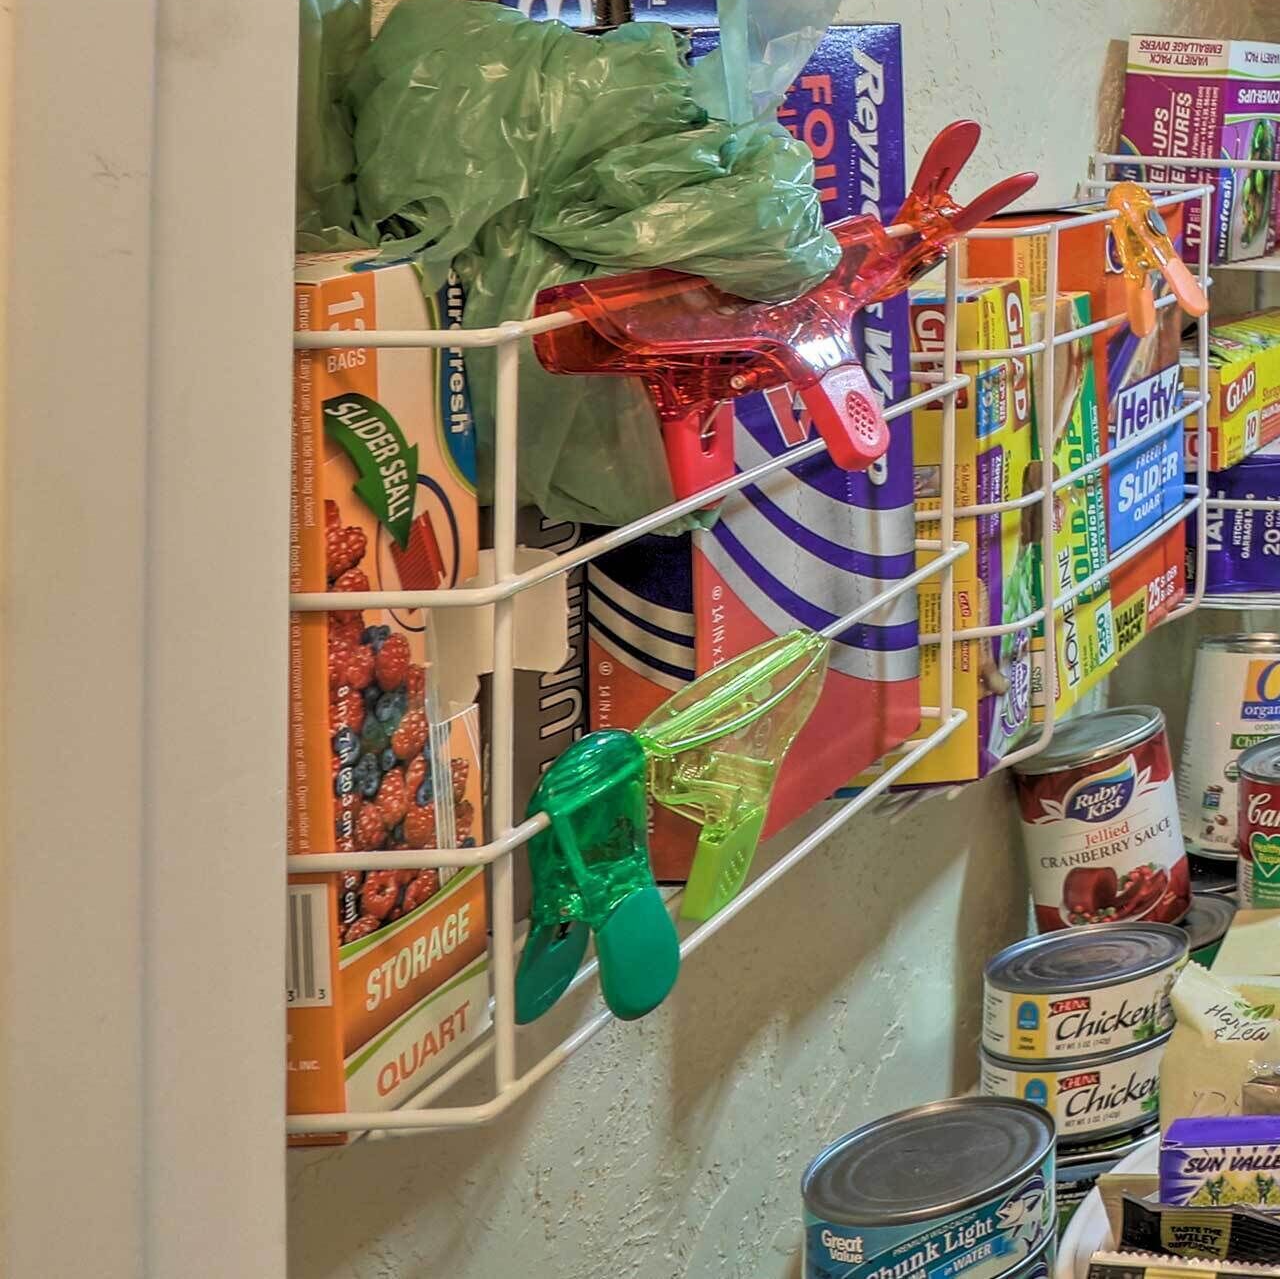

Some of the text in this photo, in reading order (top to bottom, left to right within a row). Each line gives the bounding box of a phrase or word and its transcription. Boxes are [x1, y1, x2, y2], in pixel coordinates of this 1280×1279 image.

[1149, 53, 1172, 65] PACK
[802, 74, 838, 202] FOIL
[1217, 179, 1233, 259] surefresh
[327, 348, 367, 373] BAGS
[1226, 370, 1256, 413] GLAD
[1246, 416, 1257, 440] 10
[324, 402, 411, 523] SLIDER SEAL!
[1118, 450, 1178, 513] SLIDER
[1115, 596, 1146, 631] VALUE
[1148, 583, 1161, 612] 25
[1074, 782, 1122, 811] Ruby
[1086, 795, 1123, 821] Kist
[1040, 816, 1170, 869] CRANBERRY SAUCE
[1084, 821, 1130, 849] Jellied
[366, 903, 470, 1011] STORAGE
[1056, 999, 1157, 1042] Chicken
[376, 1000, 471, 1097] QUART
[1183, 1155, 1222, 1174] SUN
[821, 1230, 865, 1253] Great
[943, 1216, 994, 1253] Light
[830, 1248, 864, 1265] Value
[954, 1243, 993, 1273] WATER
